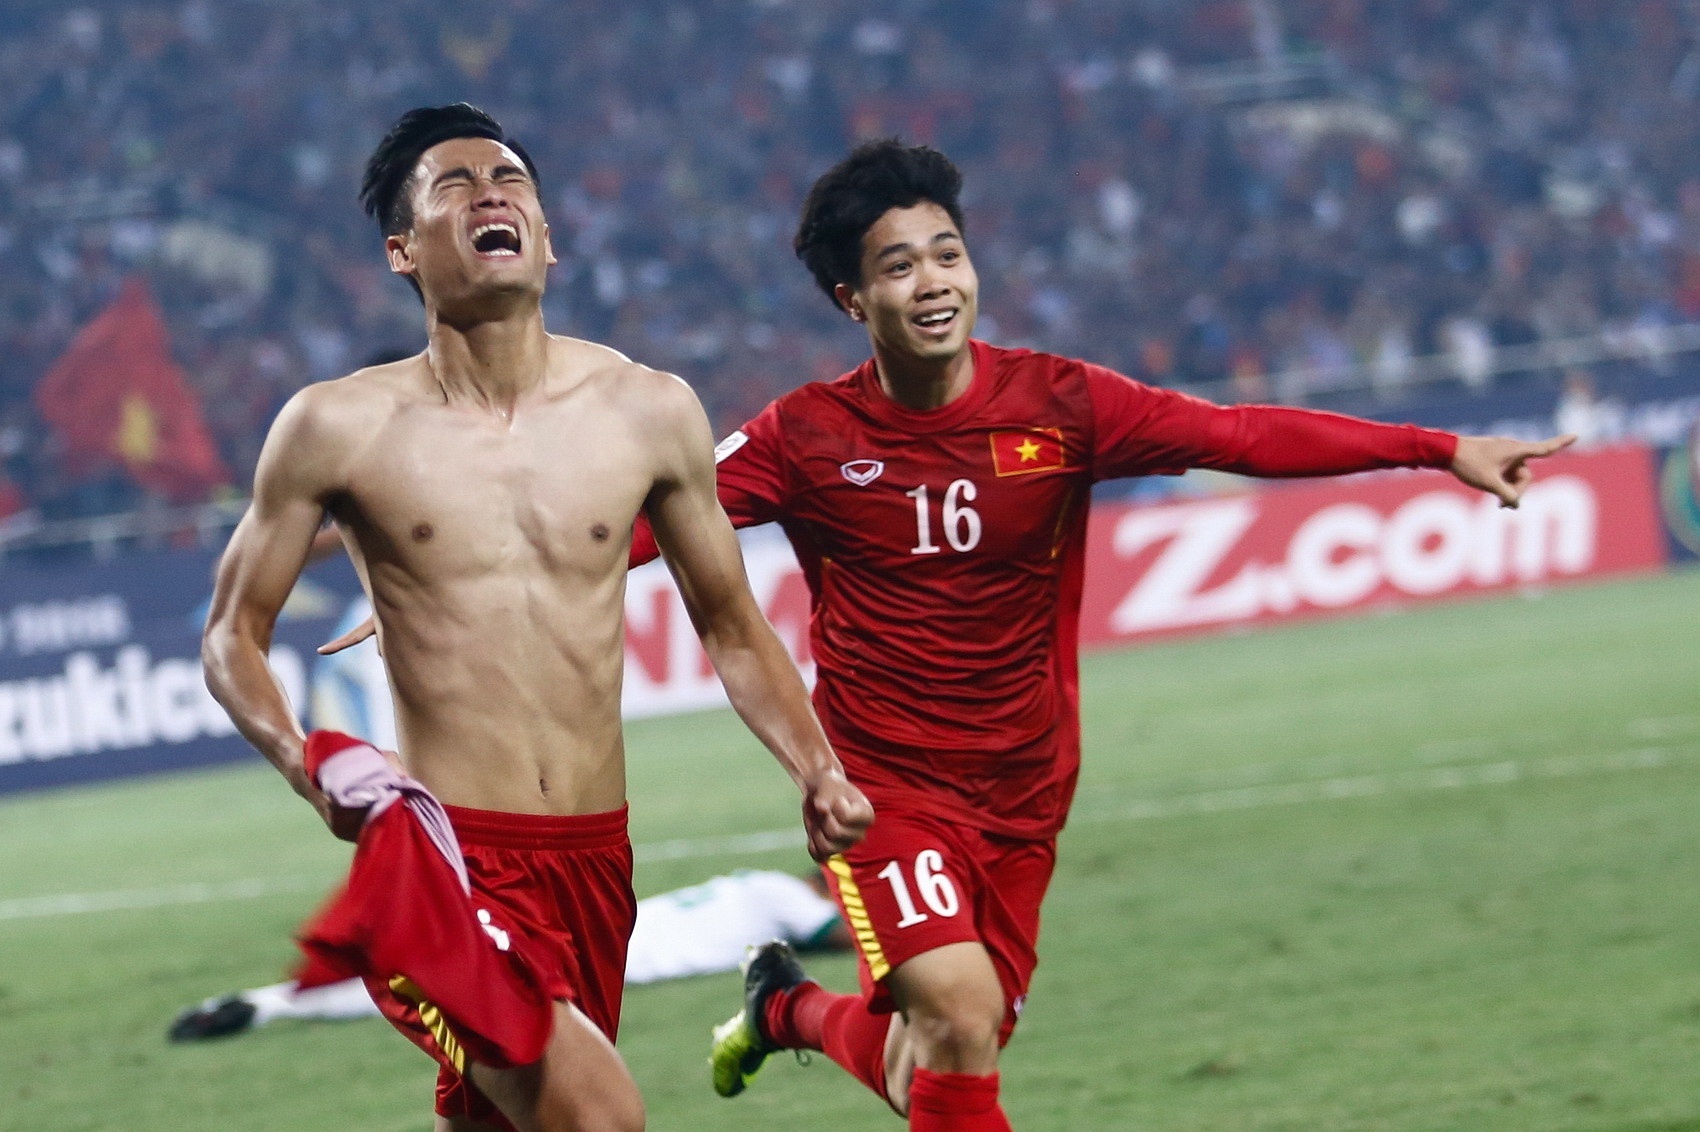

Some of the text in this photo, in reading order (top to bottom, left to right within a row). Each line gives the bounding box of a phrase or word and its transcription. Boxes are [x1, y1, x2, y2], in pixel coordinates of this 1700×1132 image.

[906, 478, 981, 555] 16
[1111, 475, 1598, 635] Z.com
[877, 849, 959, 929] 16
